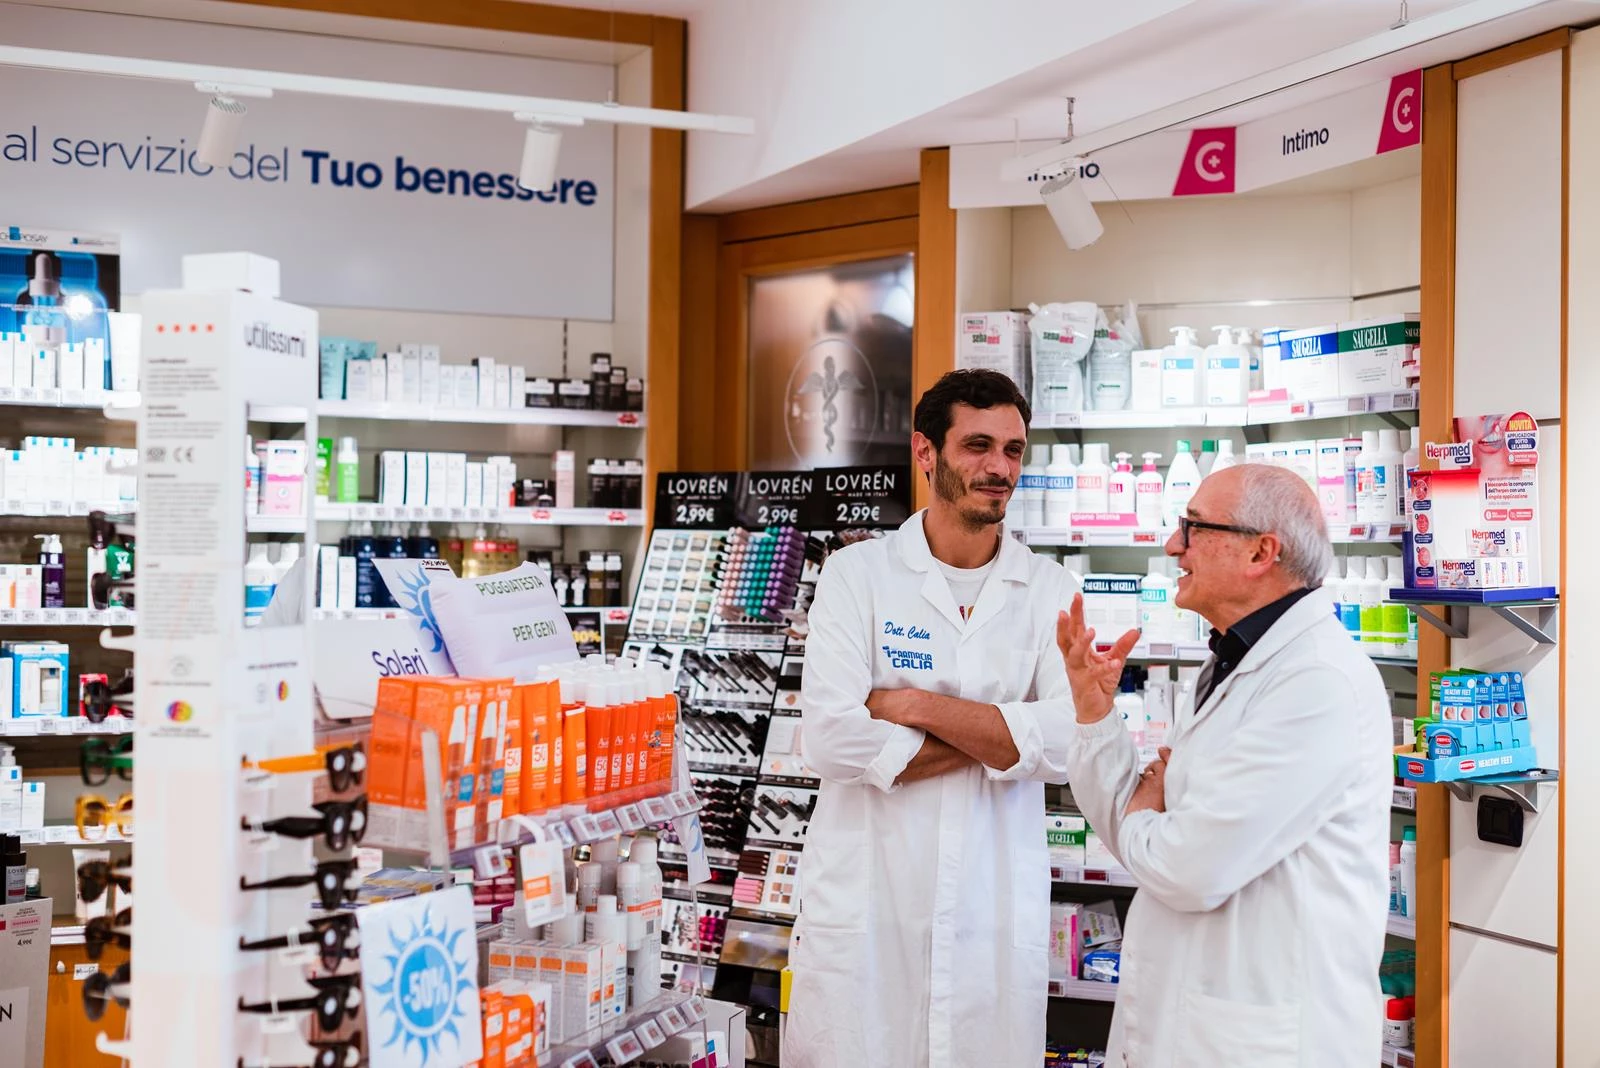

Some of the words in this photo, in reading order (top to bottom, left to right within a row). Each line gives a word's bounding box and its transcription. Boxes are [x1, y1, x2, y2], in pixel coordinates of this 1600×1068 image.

[1282, 126, 1330, 156] Intimo
[2, 126, 37, 163] al
[51, 136, 214, 176] servizio
[228, 144, 289, 182] del
[302, 149, 384, 188] Tuo
[1291, 336, 1322, 358] SAUGELLA
[1352, 327, 1388, 349] SAUGELLA
[1509, 417, 1532, 430] NOVITÀ
[1427, 441, 1471, 460] Herpmed
[668, 476, 728, 495] LOVRÉN
[748, 475, 813, 494] LOVRÉN
[826, 470, 895, 491] LOVRÉN
[676, 505, 715, 525] 2,99€
[757, 506, 798, 525] 2,99€
[836, 503, 880, 524] 2,99€
[1472, 529, 1506, 541] Herpmed
[1442, 560, 1475, 573] Herpmed
[476, 575, 544, 596] POGGIATESTA
[512, 624, 533, 642] PER
[535, 620, 557, 639] GENI
[884, 621, 905, 636] Dott.
[907, 626, 930, 640] Calia
[372, 647, 428, 677] Solari
[892, 658, 933, 670] CALIA
[1479, 758, 1500, 768] HEALTHY
[1501, 755, 1513, 765] FEET
